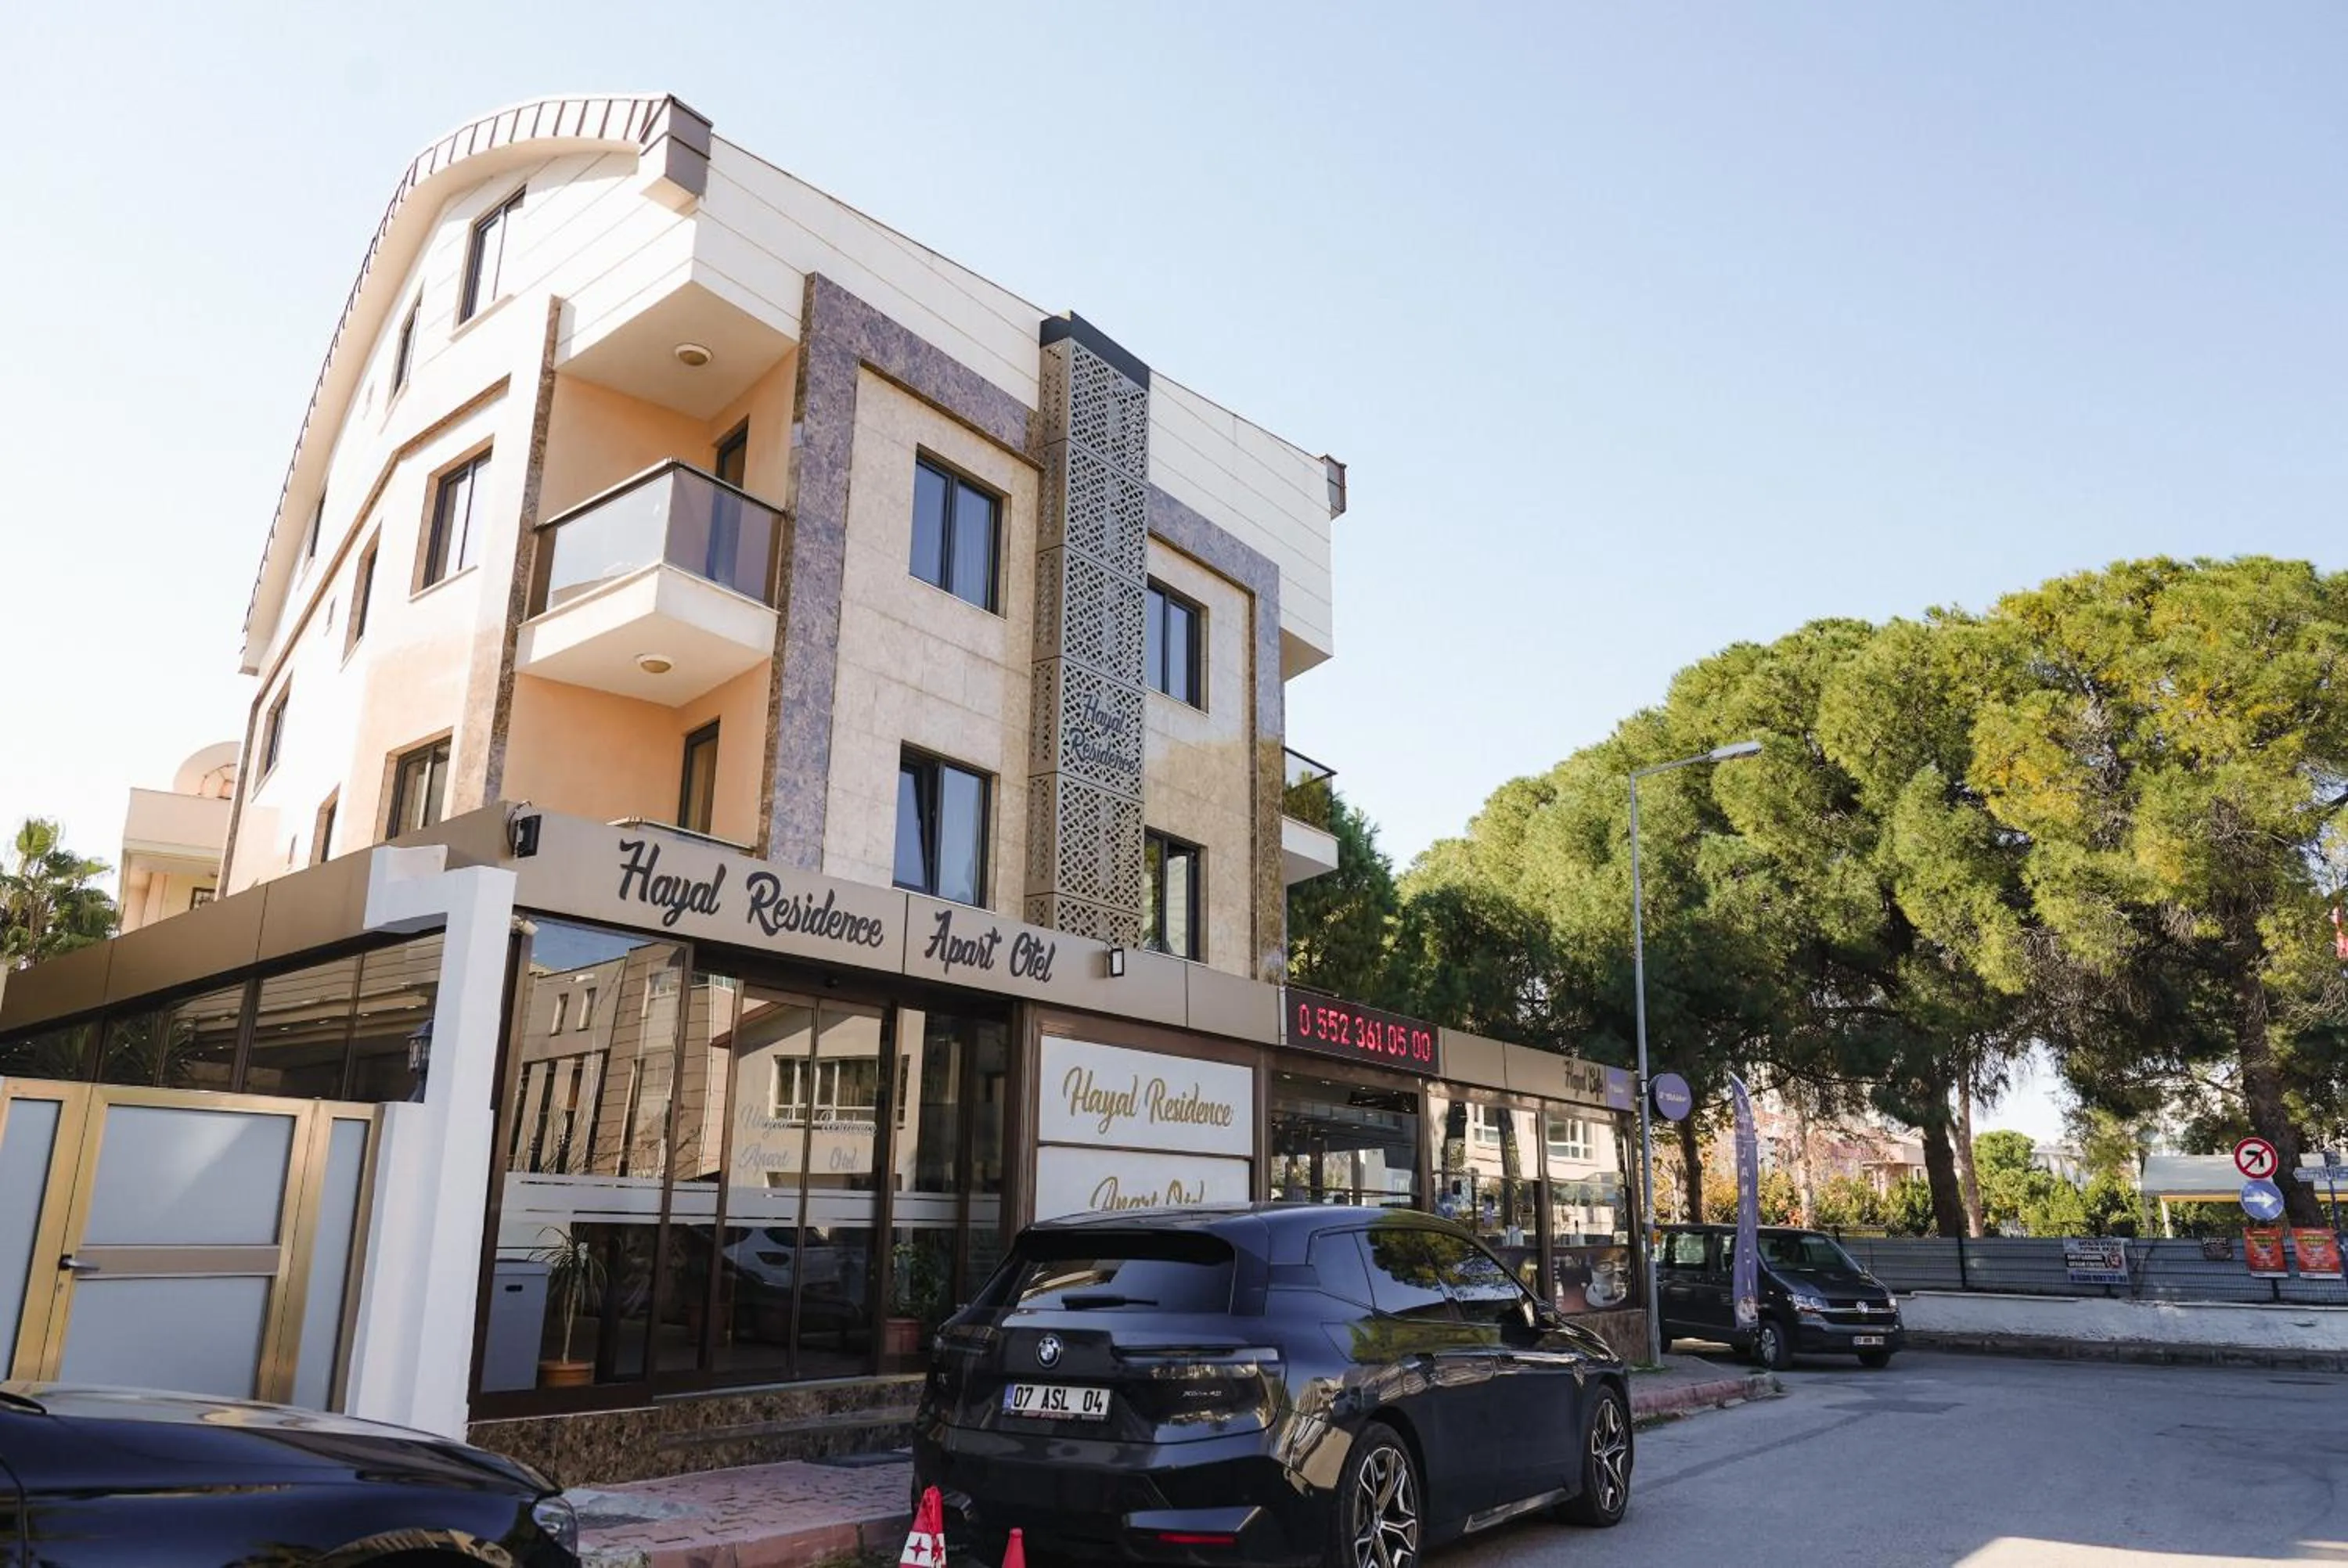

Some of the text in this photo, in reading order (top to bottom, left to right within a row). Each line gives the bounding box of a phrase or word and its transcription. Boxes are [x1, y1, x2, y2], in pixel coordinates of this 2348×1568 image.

[1083, 693, 1125, 735] Hayal
[1069, 728, 1135, 775] Residence
[619, 837, 884, 948] Hayal Residence
[924, 910, 1057, 984] Apart Otel
[1298, 1003, 1431, 1063] 0 552 361 05 00
[1062, 1066, 1234, 1135] Hayal Residence
[1014, 1386, 1103, 1412] 07 ASL 04
